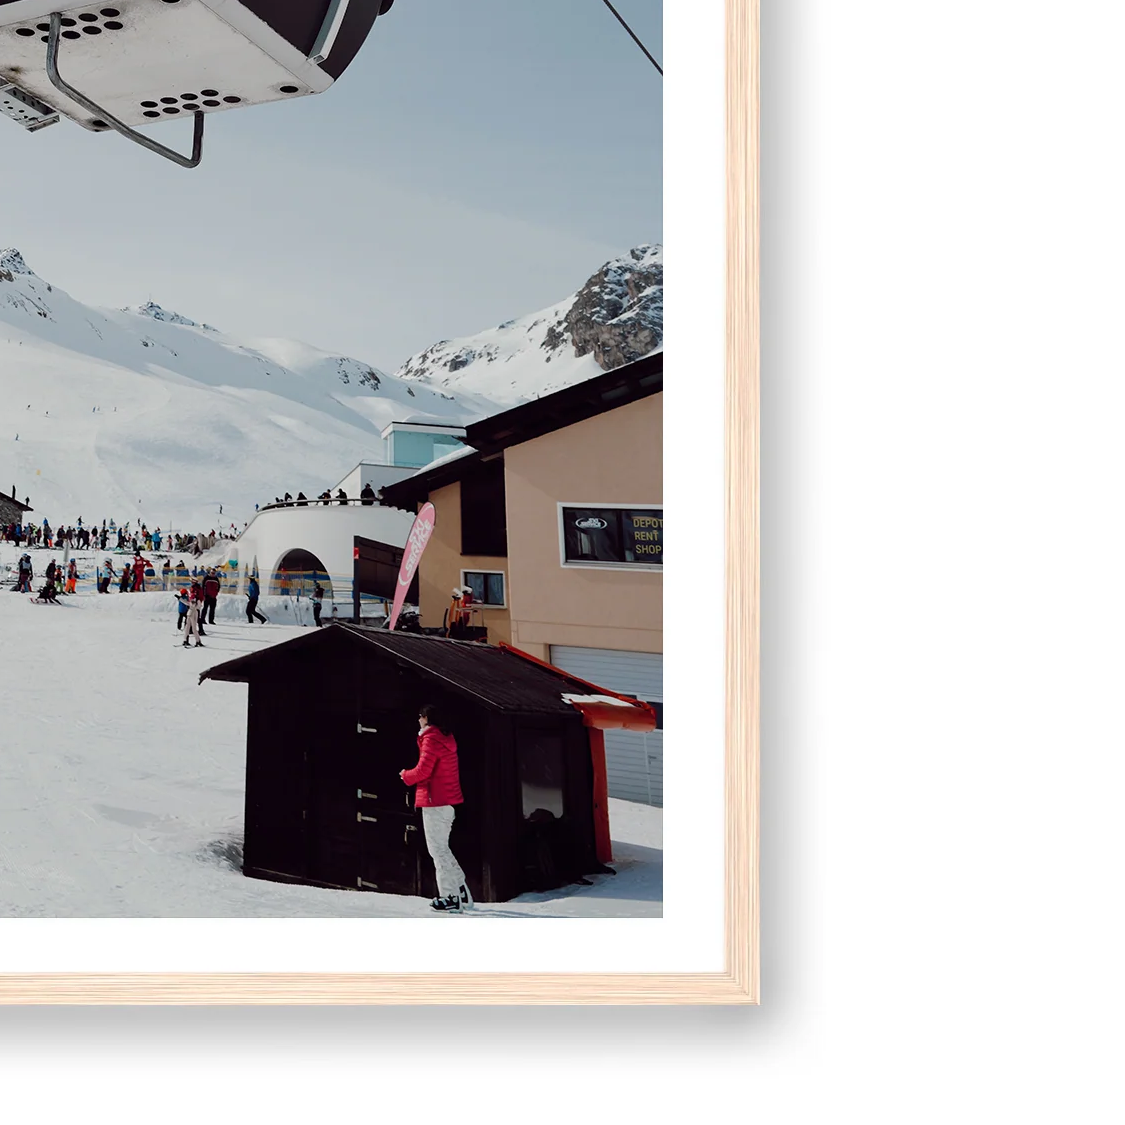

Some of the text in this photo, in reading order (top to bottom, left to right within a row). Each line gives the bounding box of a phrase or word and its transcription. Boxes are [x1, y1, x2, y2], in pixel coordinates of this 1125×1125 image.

[633, 518, 663, 528] DEPOT
[408, 518, 425, 543] SKI
[634, 530, 659, 541] RENT
[405, 519, 432, 578] SERVICE
[635, 544, 662, 555] SHOP
